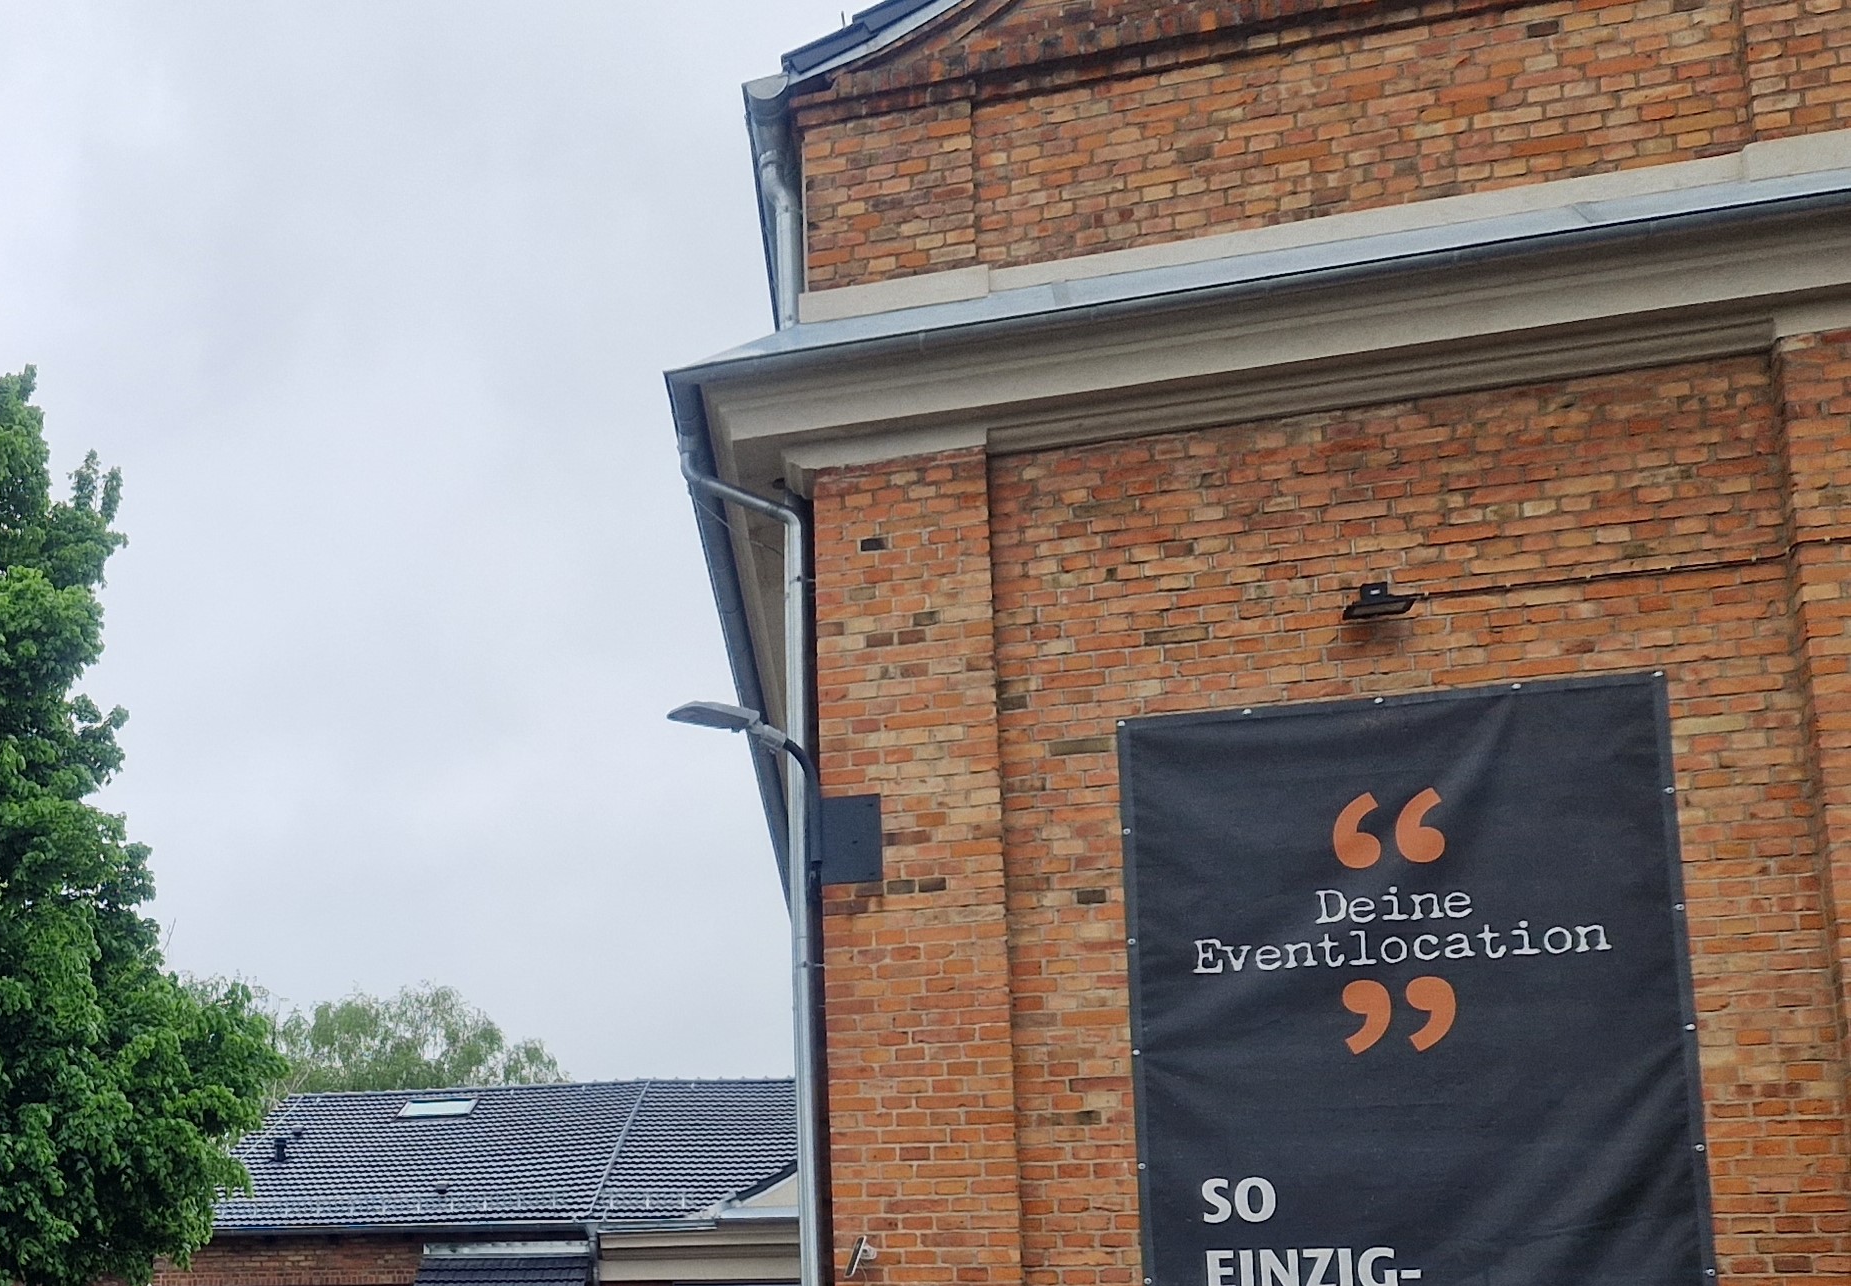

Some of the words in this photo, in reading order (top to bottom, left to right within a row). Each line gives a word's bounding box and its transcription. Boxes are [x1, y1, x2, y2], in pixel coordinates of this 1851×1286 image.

[1315, 886, 1473, 926] Deine
[1193, 919, 1613, 976] Eventlocation
[1201, 1177, 1278, 1225] SO
